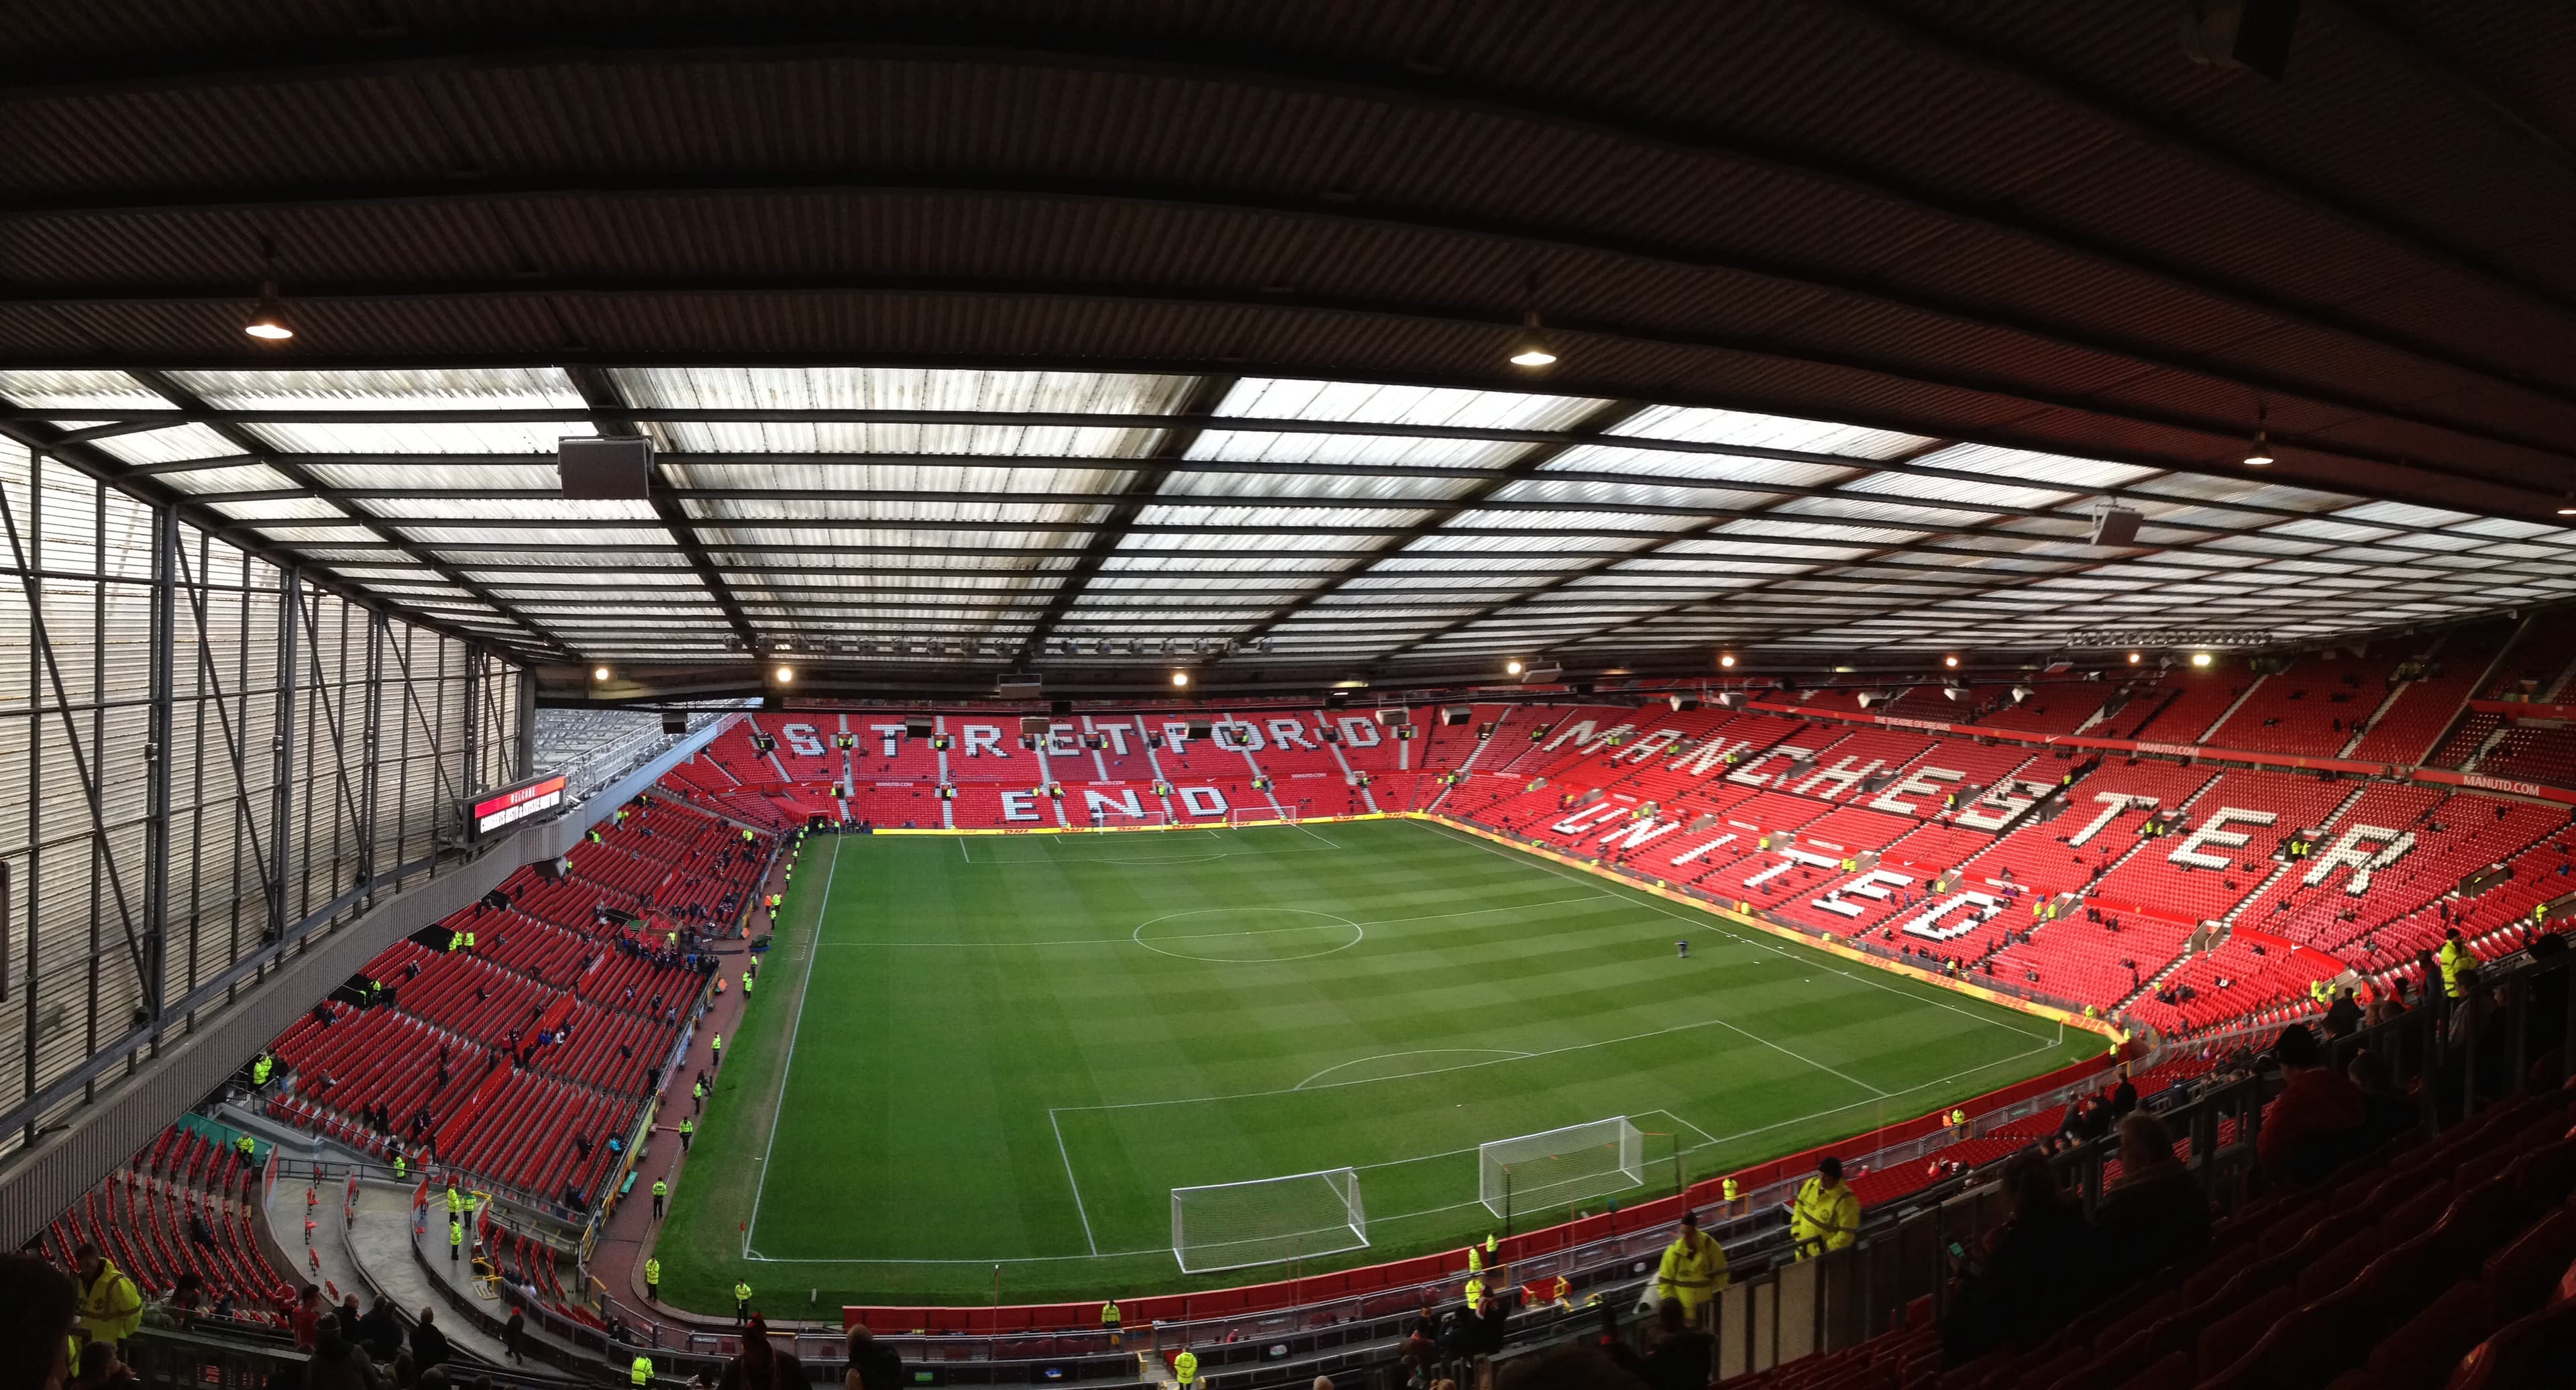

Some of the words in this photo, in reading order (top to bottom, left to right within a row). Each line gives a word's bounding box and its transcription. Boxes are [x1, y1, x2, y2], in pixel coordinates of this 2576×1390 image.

[782, 716, 1381, 758] STRETFORD
[2137, 742, 2200, 757] MANUTD.COM
[511, 786, 536, 804] WELCOME
[2463, 775, 2540, 796] MANUTD.COM
[1001, 786, 1230, 821] END
[1543, 720, 2416, 896] MANCHESTER
[1552, 802, 2004, 941] UNITED
